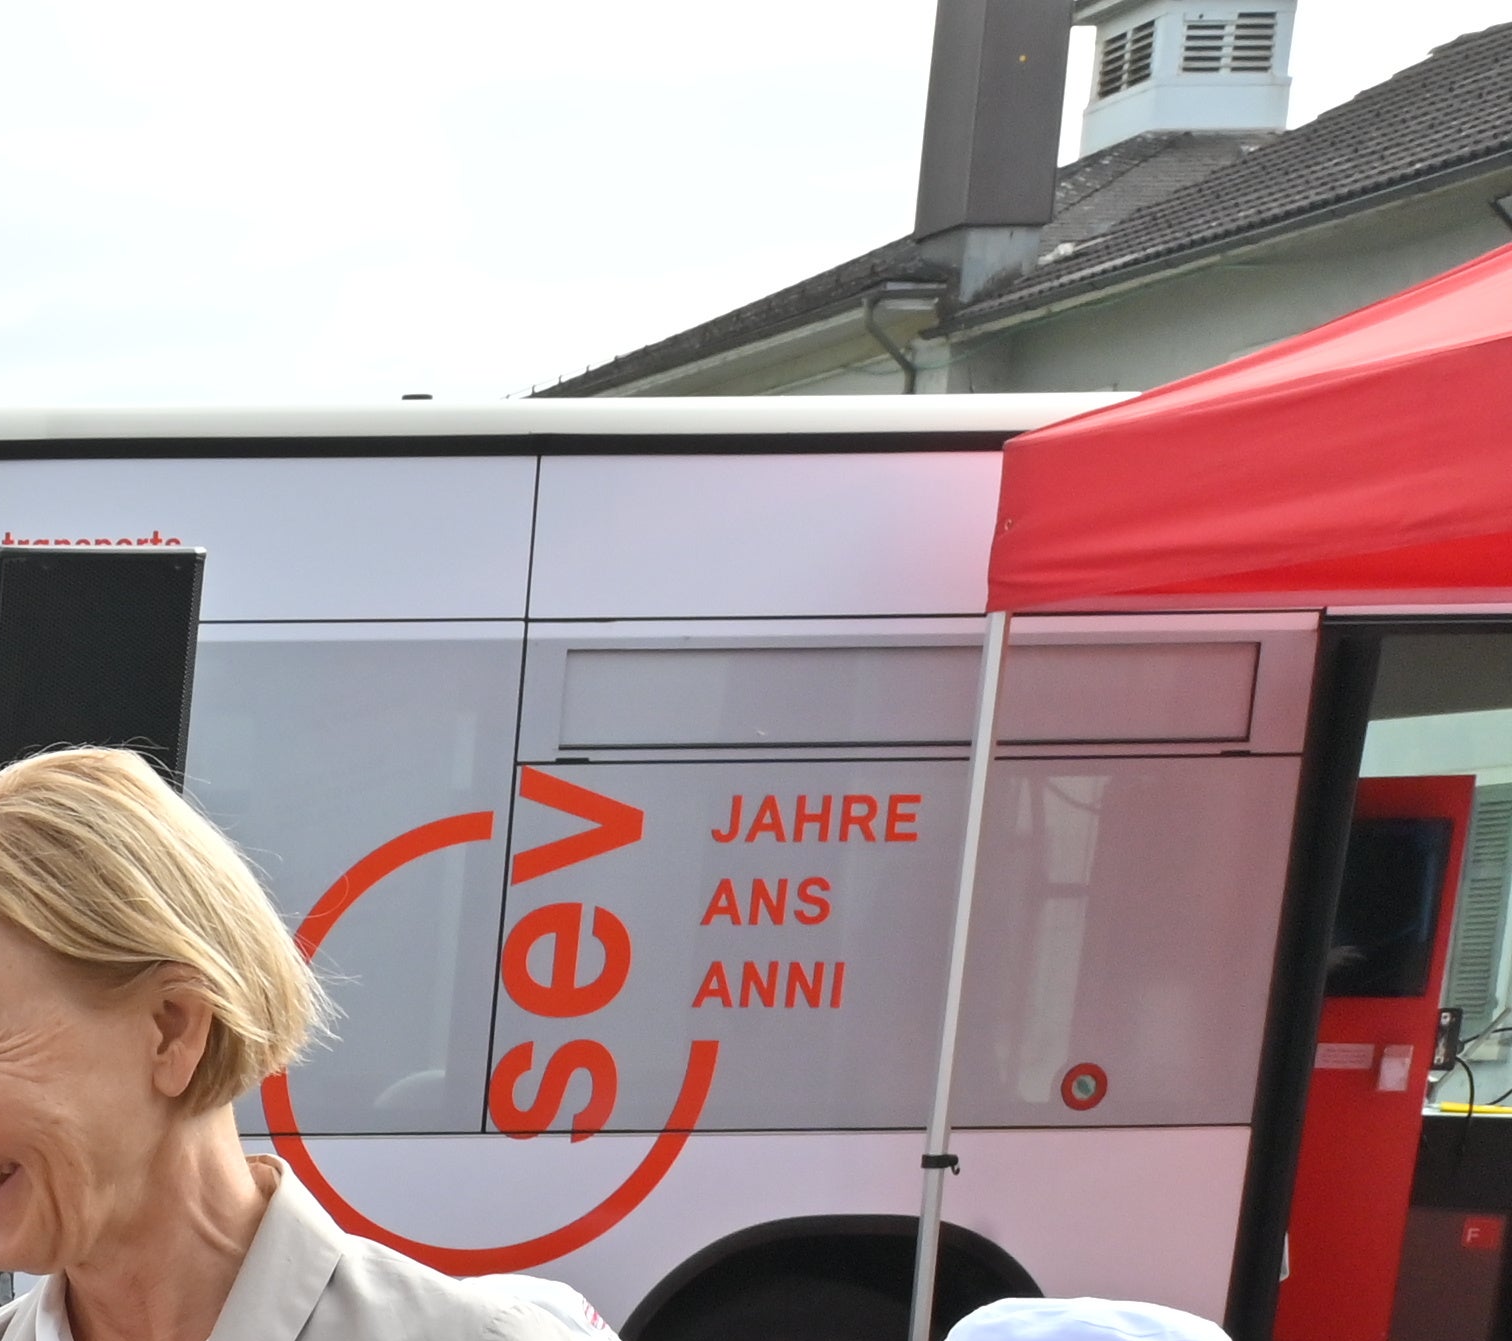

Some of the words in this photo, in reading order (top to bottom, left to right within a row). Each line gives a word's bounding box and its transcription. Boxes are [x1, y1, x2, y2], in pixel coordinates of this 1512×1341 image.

[710, 793, 924, 844] JAHRE
[700, 876, 832, 927] ANS
[487, 765, 645, 1144] sev
[691, 959, 846, 1009] ANNI
